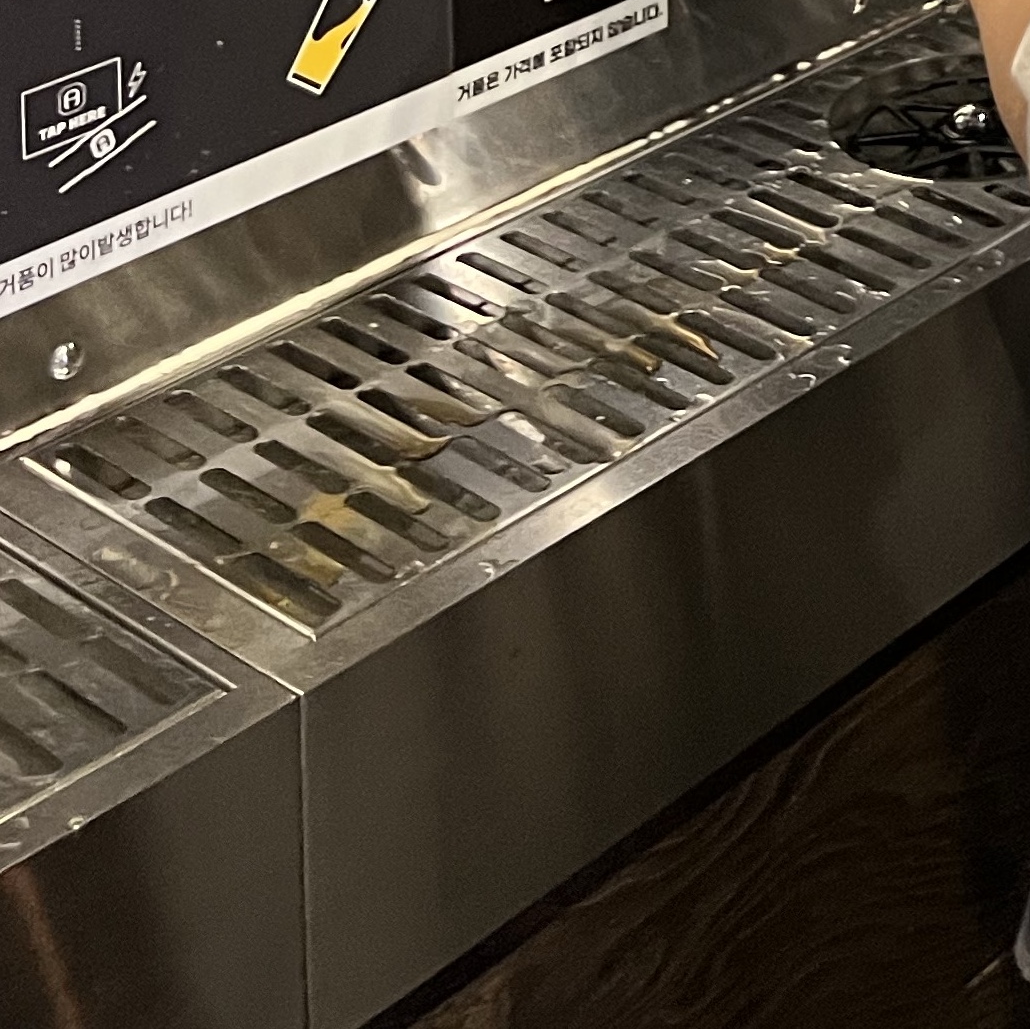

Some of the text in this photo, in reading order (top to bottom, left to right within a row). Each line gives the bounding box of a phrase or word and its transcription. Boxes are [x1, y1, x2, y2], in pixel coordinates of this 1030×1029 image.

[457, 71, 500, 102] 거은
[504, 51, 546, 83] 가격
[38, 121, 67, 141] TAP
[0, 257, 54, 296] 거품이
